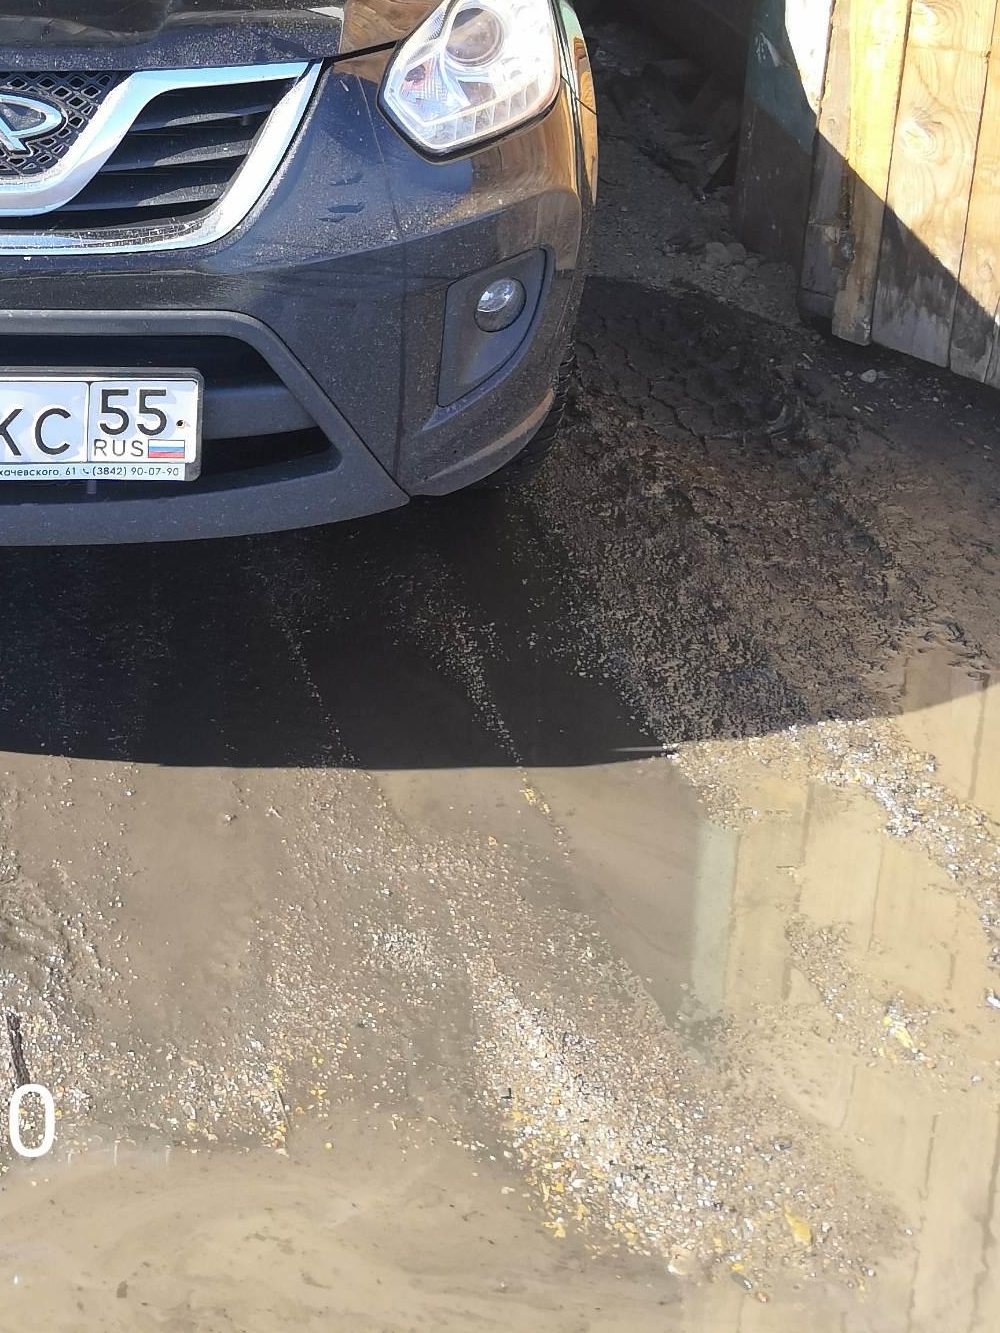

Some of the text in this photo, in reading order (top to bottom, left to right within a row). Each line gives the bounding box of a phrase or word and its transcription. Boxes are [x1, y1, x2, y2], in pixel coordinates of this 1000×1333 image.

[99, 388, 168, 436] 55
[93, 438, 145, 458] RUS
[65, 466, 76, 476] 61
[92, 466, 127, 478] (3842)
[131, 467, 179, 477] 90-07-90
